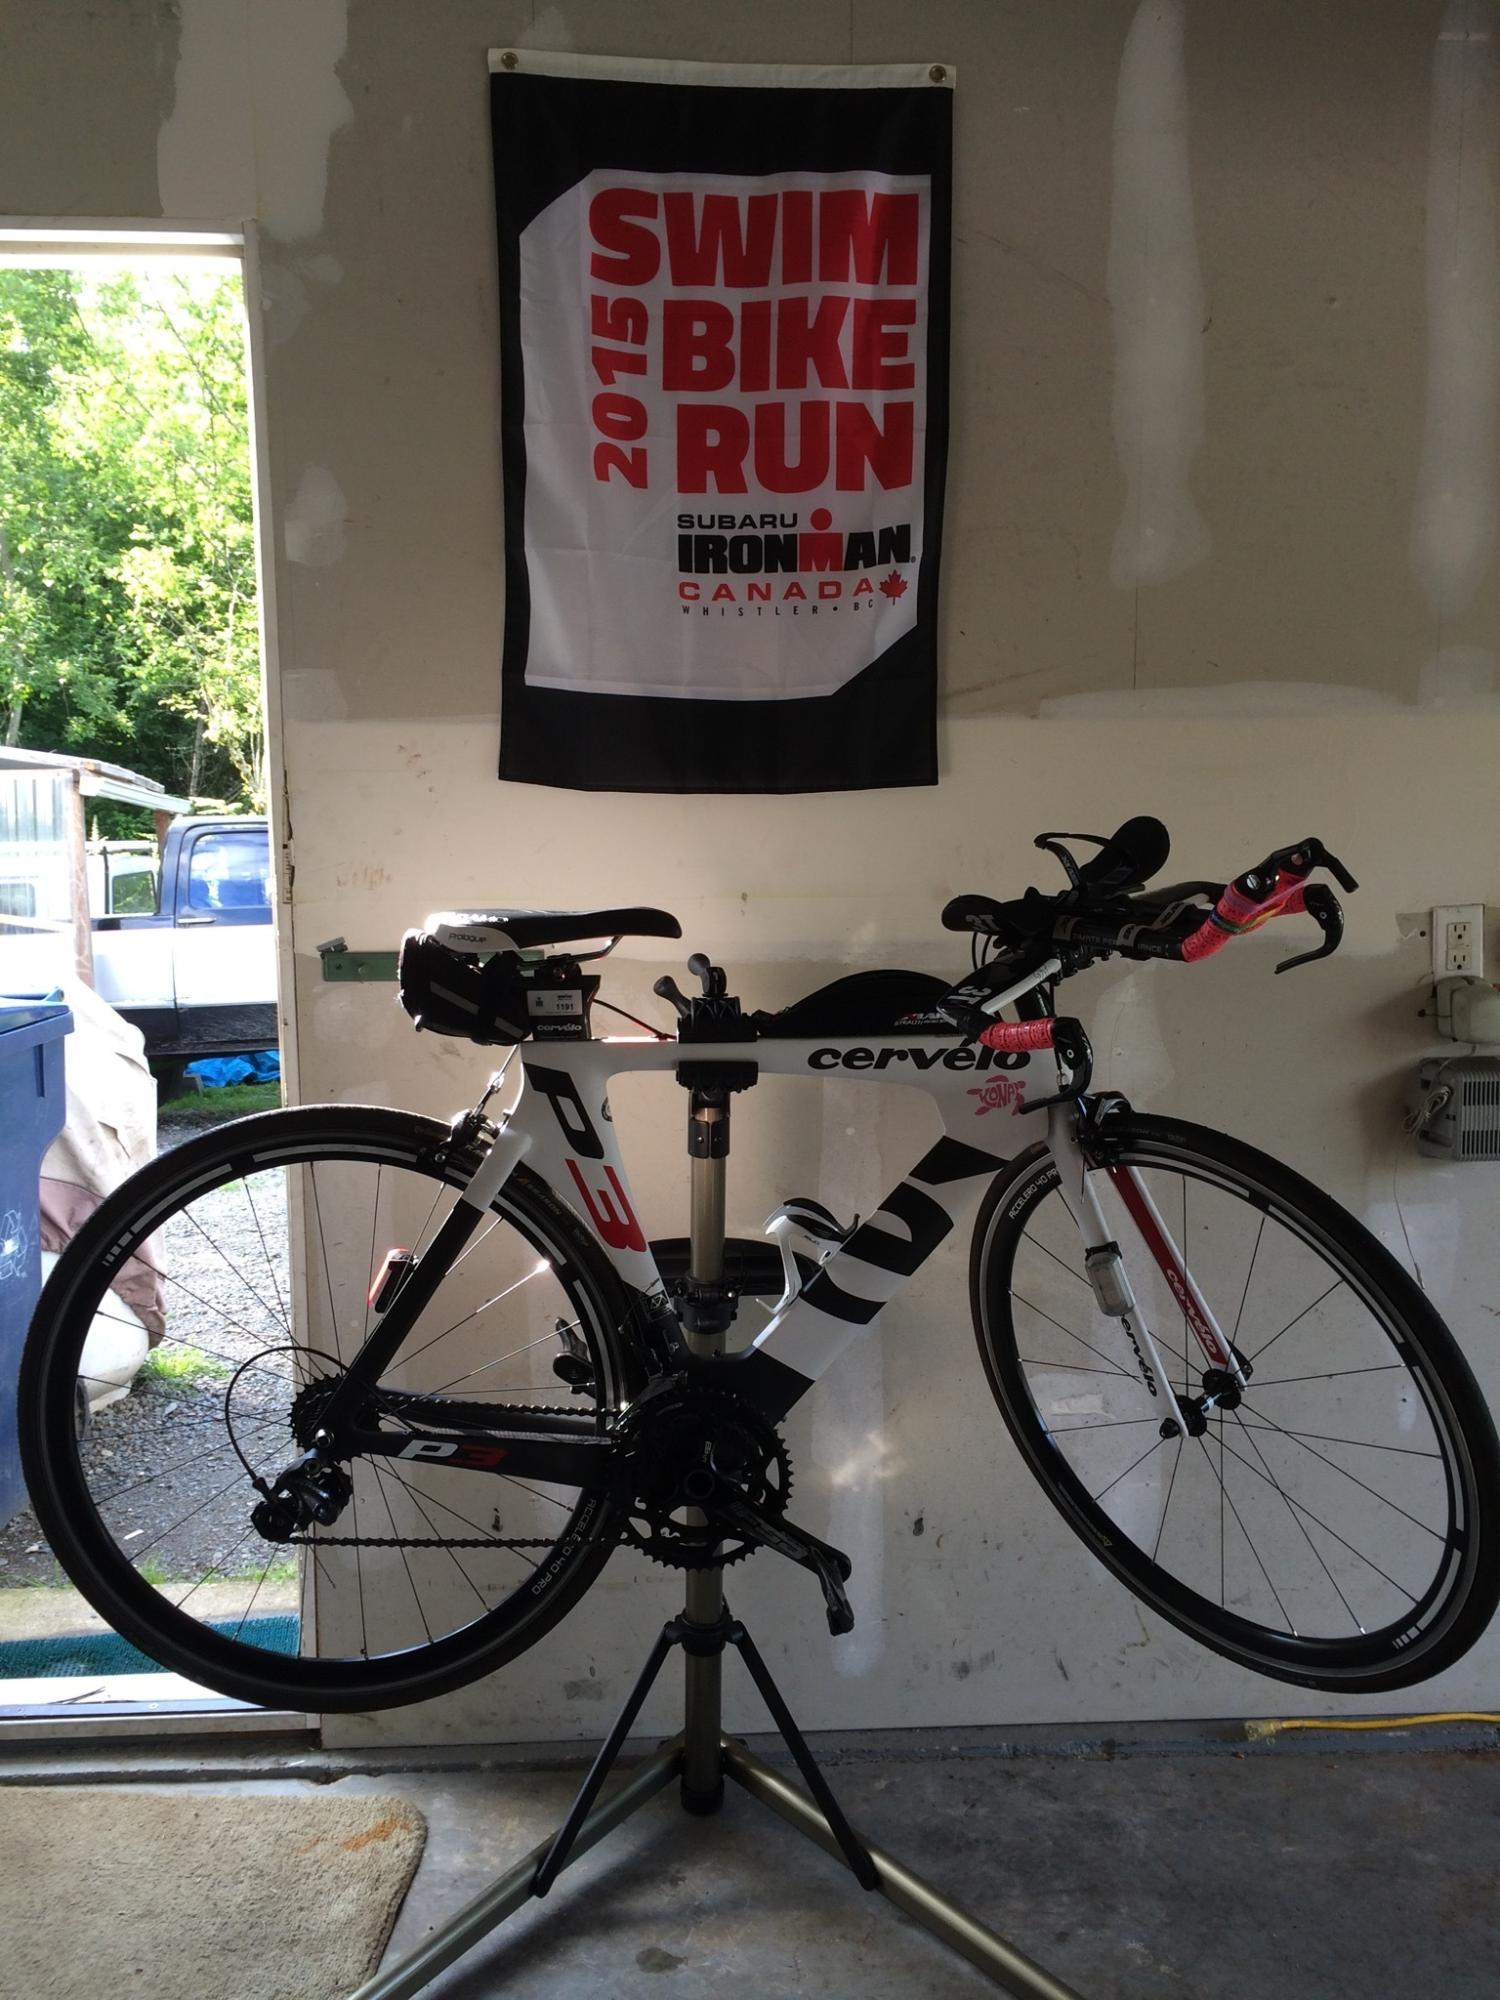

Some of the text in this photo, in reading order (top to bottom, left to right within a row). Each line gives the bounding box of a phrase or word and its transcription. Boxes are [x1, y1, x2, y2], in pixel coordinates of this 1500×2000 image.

[588, 187, 919, 288] SWIM
[662, 296, 917, 393] BIKE
[591, 294, 649, 489] 2015
[677, 401, 914, 494] RUN
[677, 513, 798, 530] SUBARU
[678, 522, 911, 574] IRONMAN
[679, 578, 874, 602] CANADA
[682, 599, 874, 617] WHISTLER BC
[556, 1003, 574, 1011] 1191
[397, 1439, 508, 1469] P3
[531, 1571, 554, 1596] PRO
